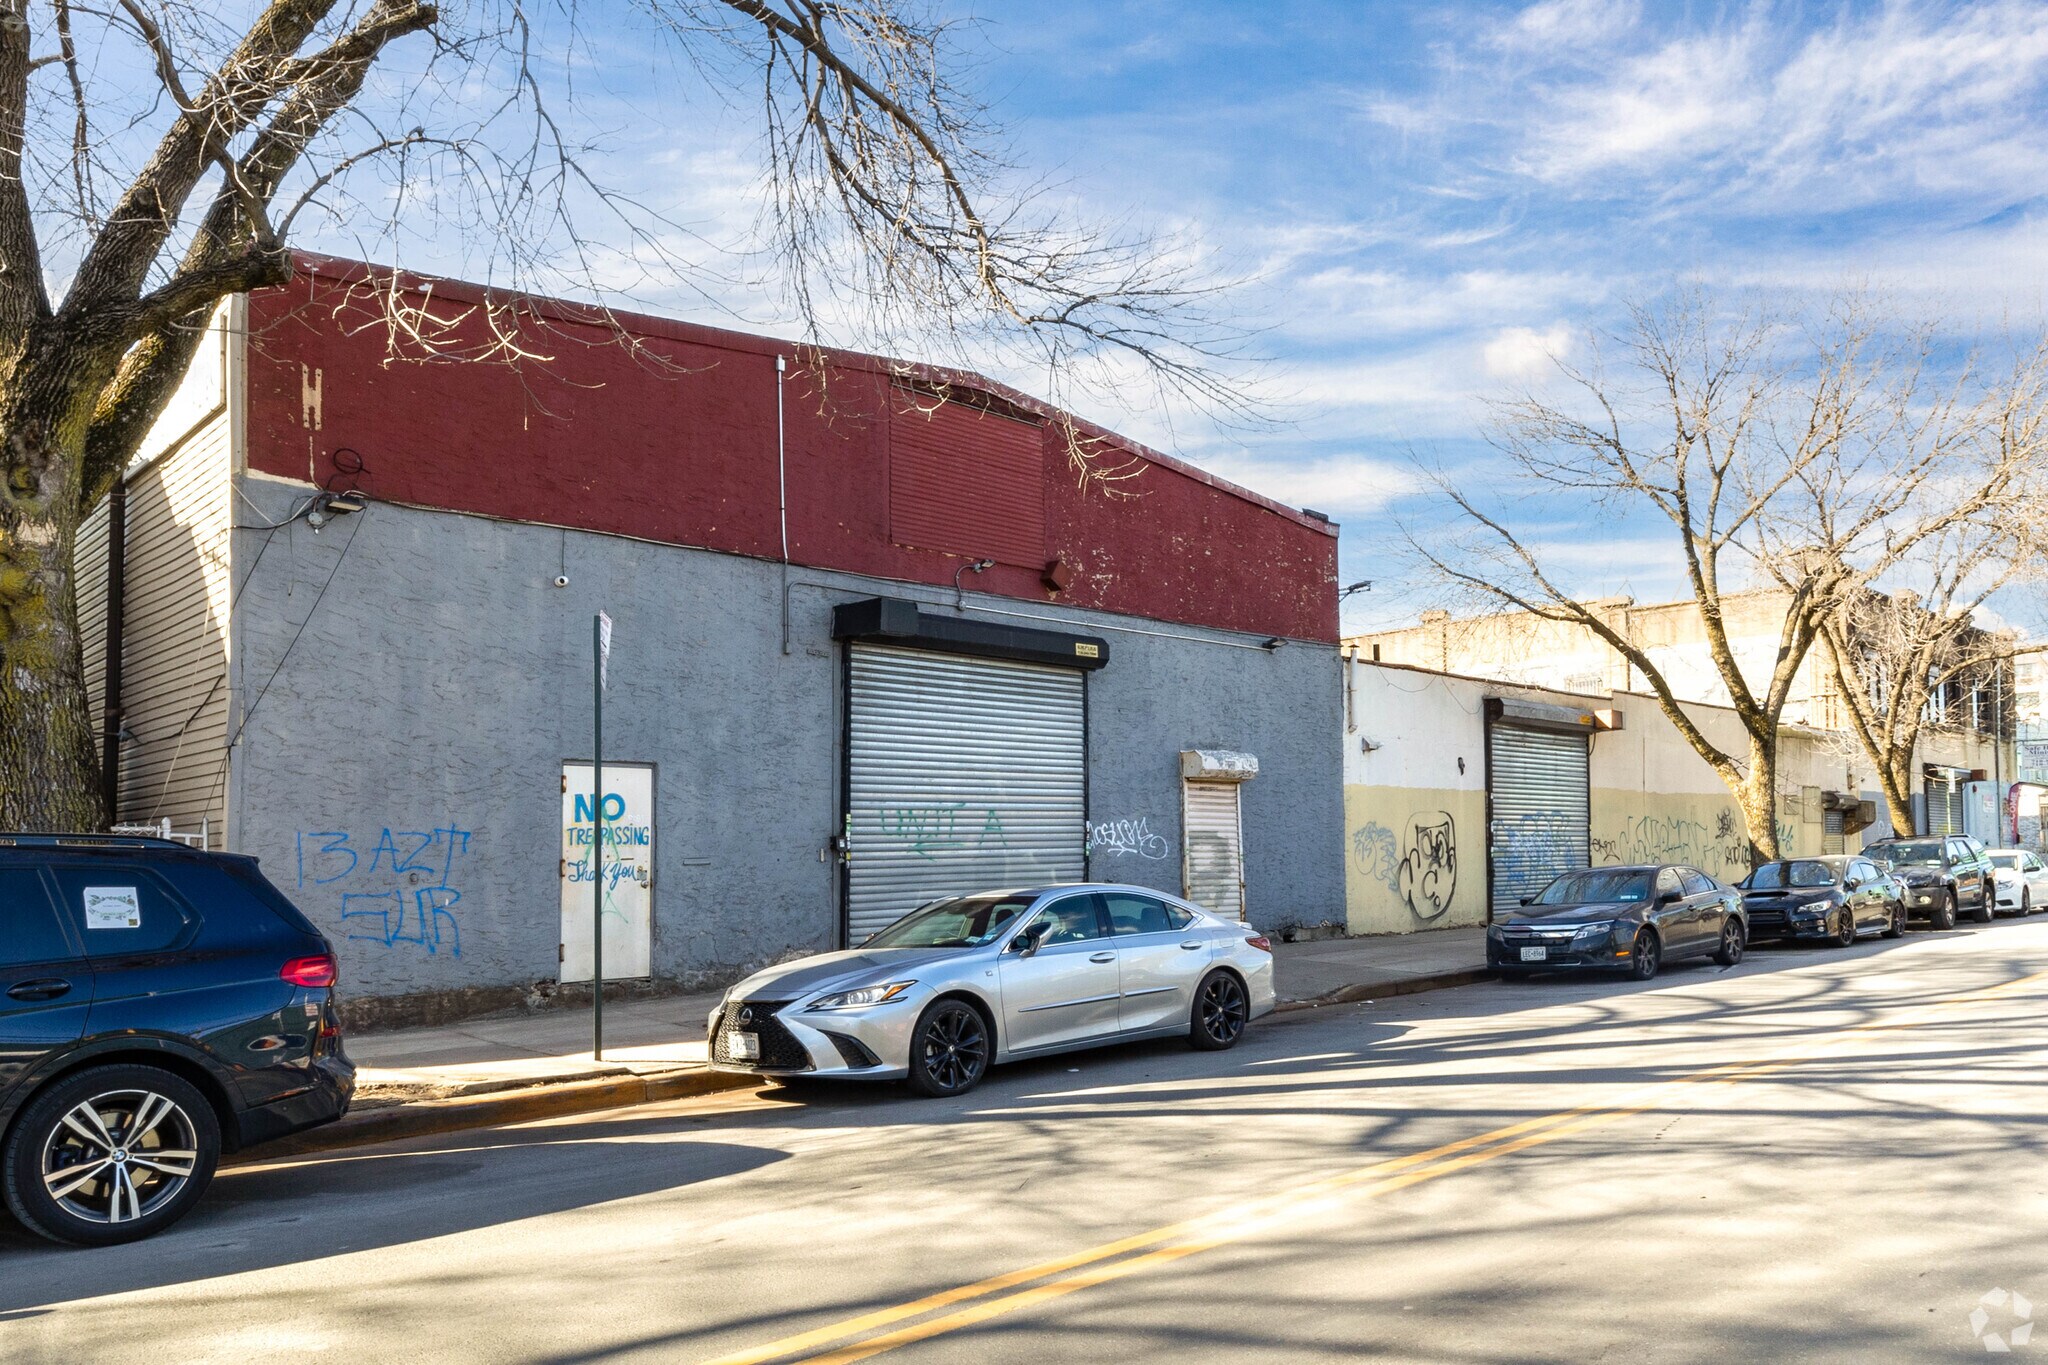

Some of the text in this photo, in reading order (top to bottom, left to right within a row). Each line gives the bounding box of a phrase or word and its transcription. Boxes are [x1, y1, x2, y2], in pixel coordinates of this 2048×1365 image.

[574, 792, 625, 823] NO
[567, 825, 650, 846] TREPASSING
[567, 859, 637, 891] Thak You
[341, 886, 462, 958] SUR
